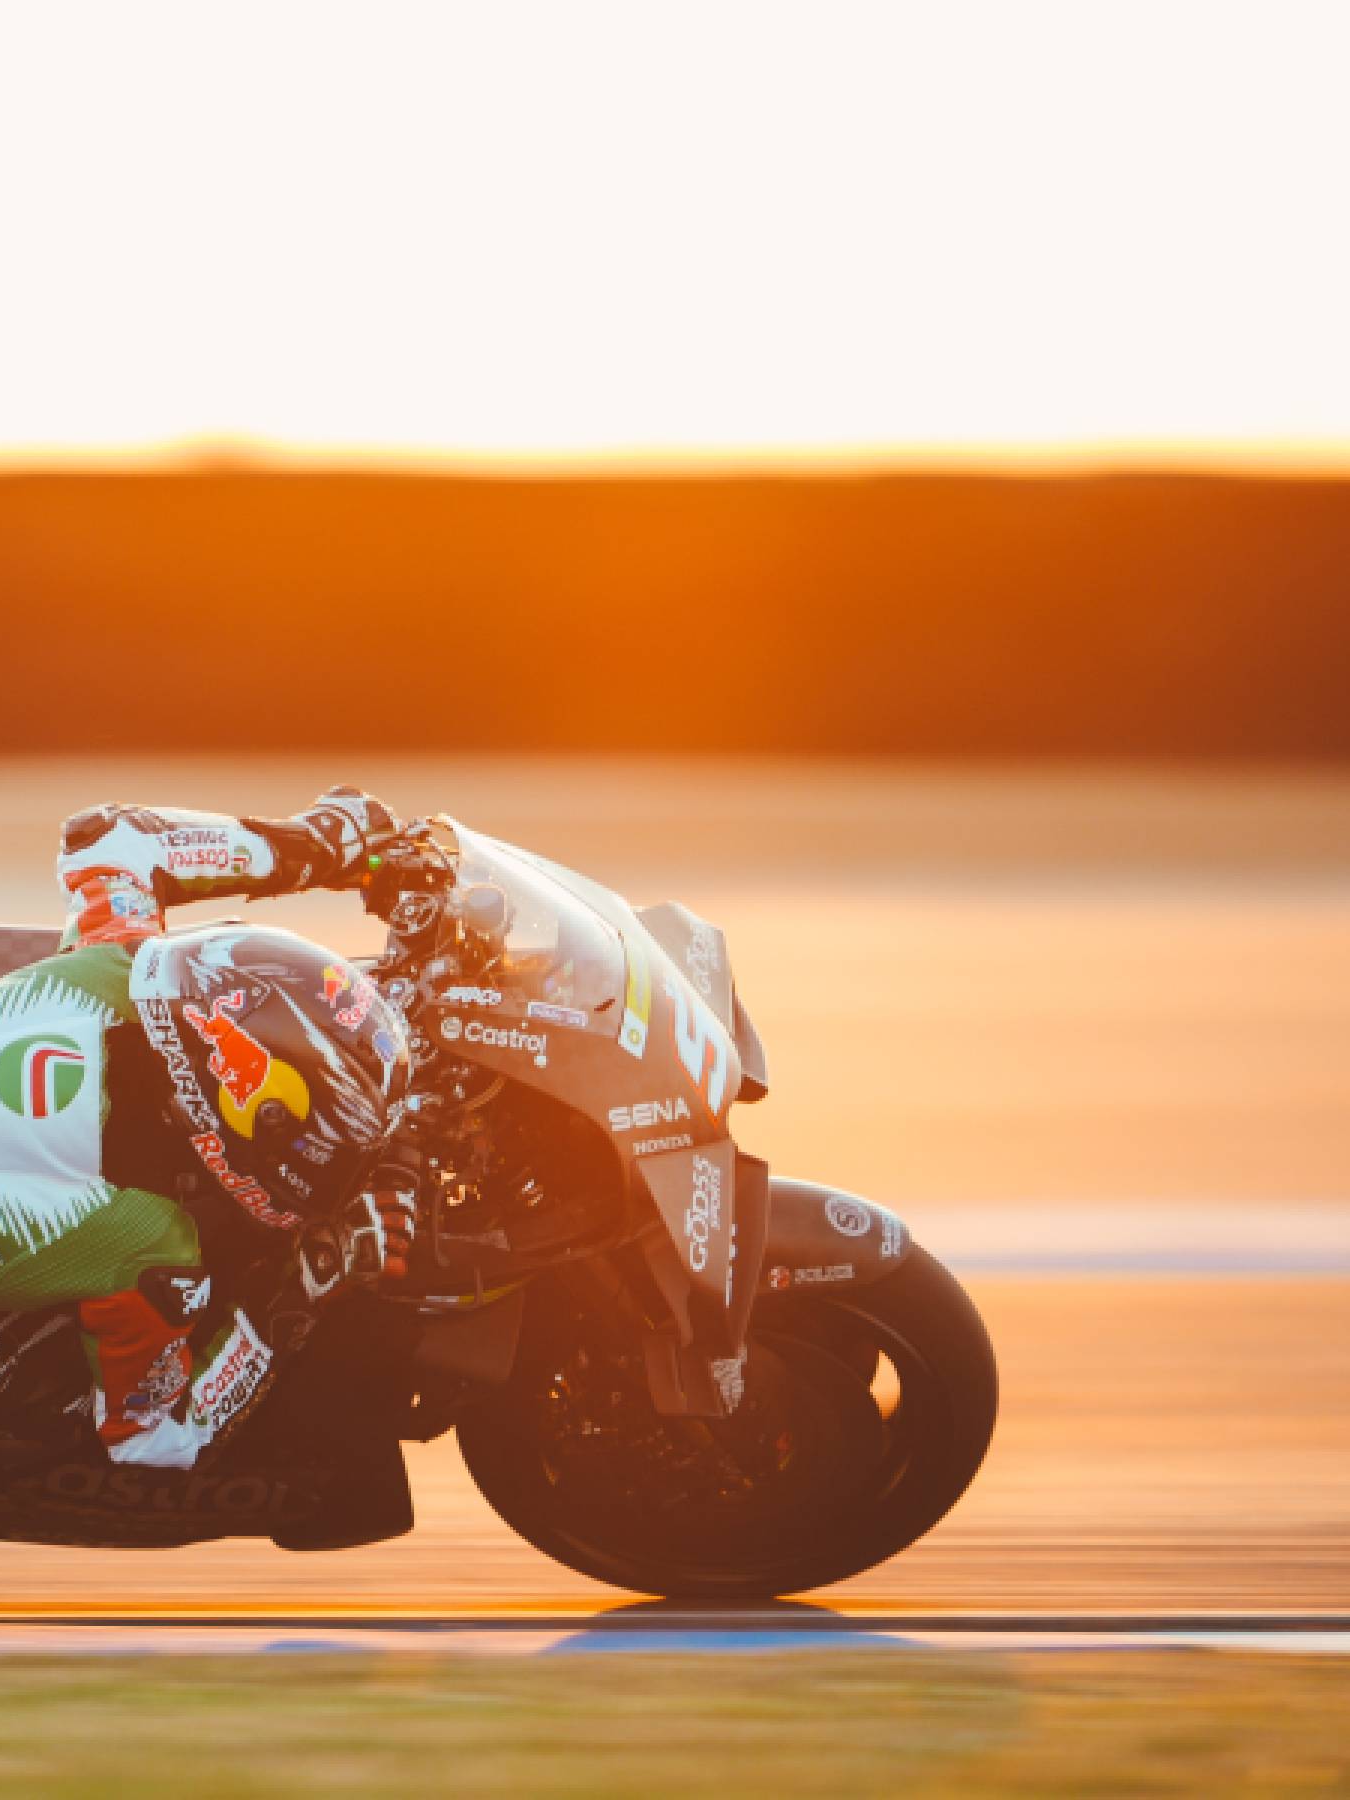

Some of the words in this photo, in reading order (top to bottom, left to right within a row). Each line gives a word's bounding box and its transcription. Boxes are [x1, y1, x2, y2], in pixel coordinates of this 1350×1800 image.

[464, 1020, 548, 1054] Castrol
[146, 998, 220, 1132] SHARK
[608, 1097, 690, 1131] SENA
[633, 1134, 692, 1156] HONDA
[45, 1464, 289, 1514] asrol
